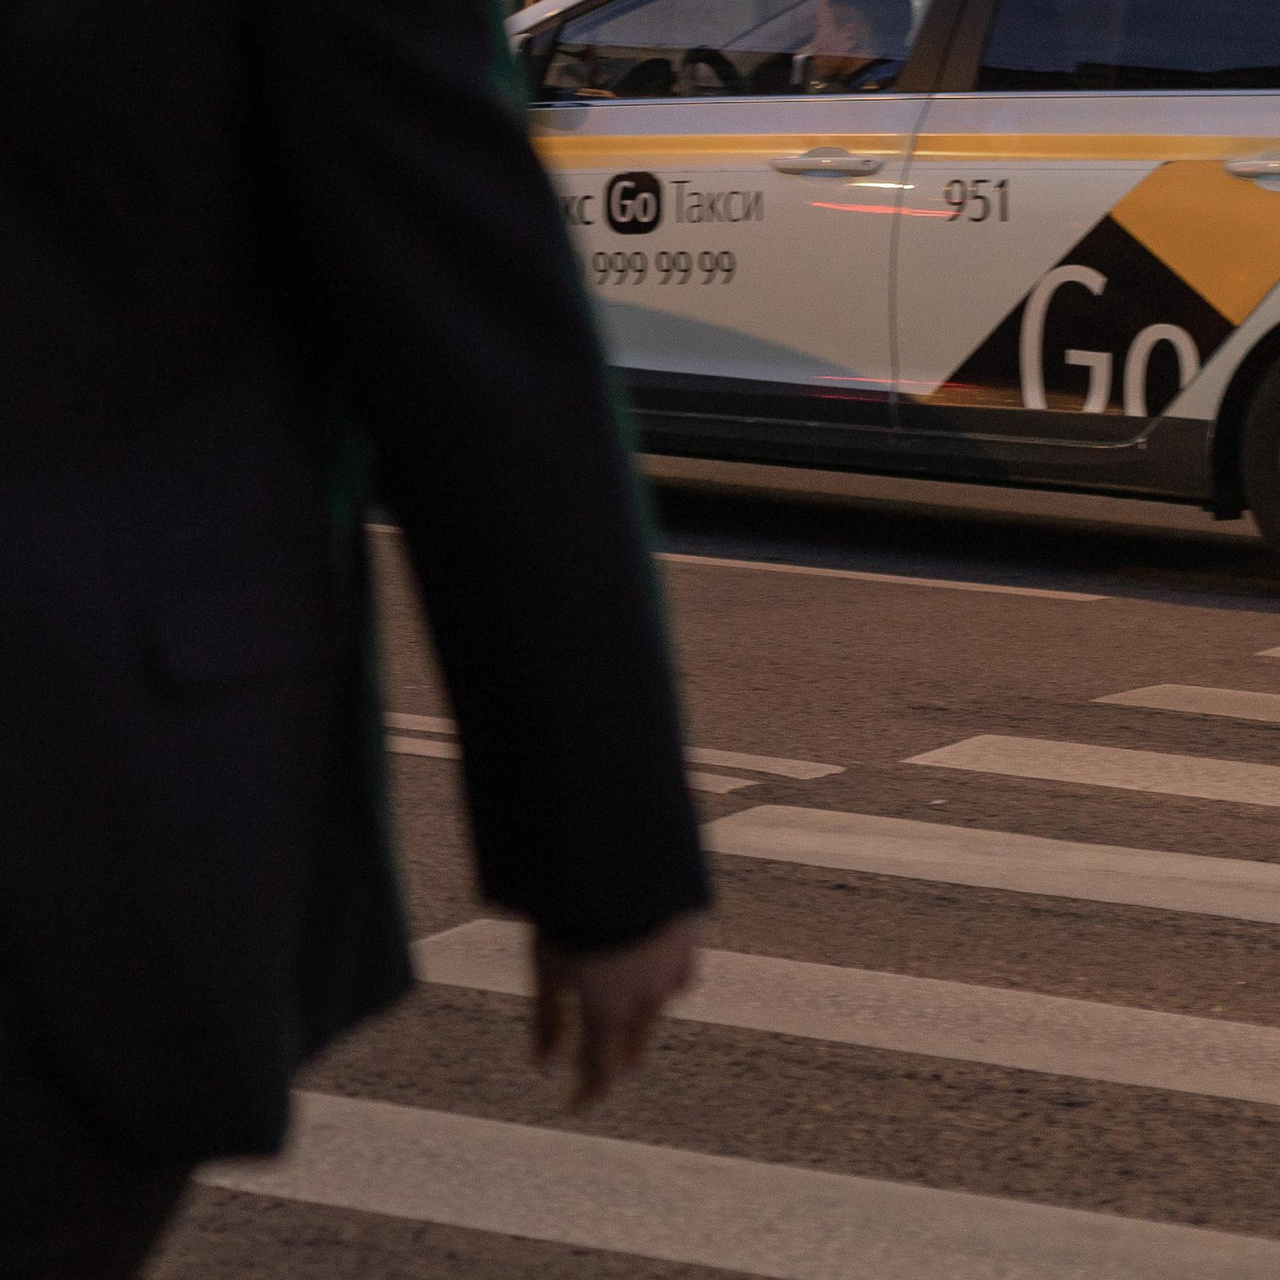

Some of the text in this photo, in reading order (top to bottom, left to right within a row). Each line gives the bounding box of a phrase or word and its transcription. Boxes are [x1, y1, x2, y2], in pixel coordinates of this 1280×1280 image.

[609, 180, 658, 224] Go
[669, 180, 766, 223] Такси
[943, 179, 1012, 222] 951
[654, 251, 694, 286] 99
[697, 250, 737, 286] 99
[1021, 264, 1203, 418] Go
